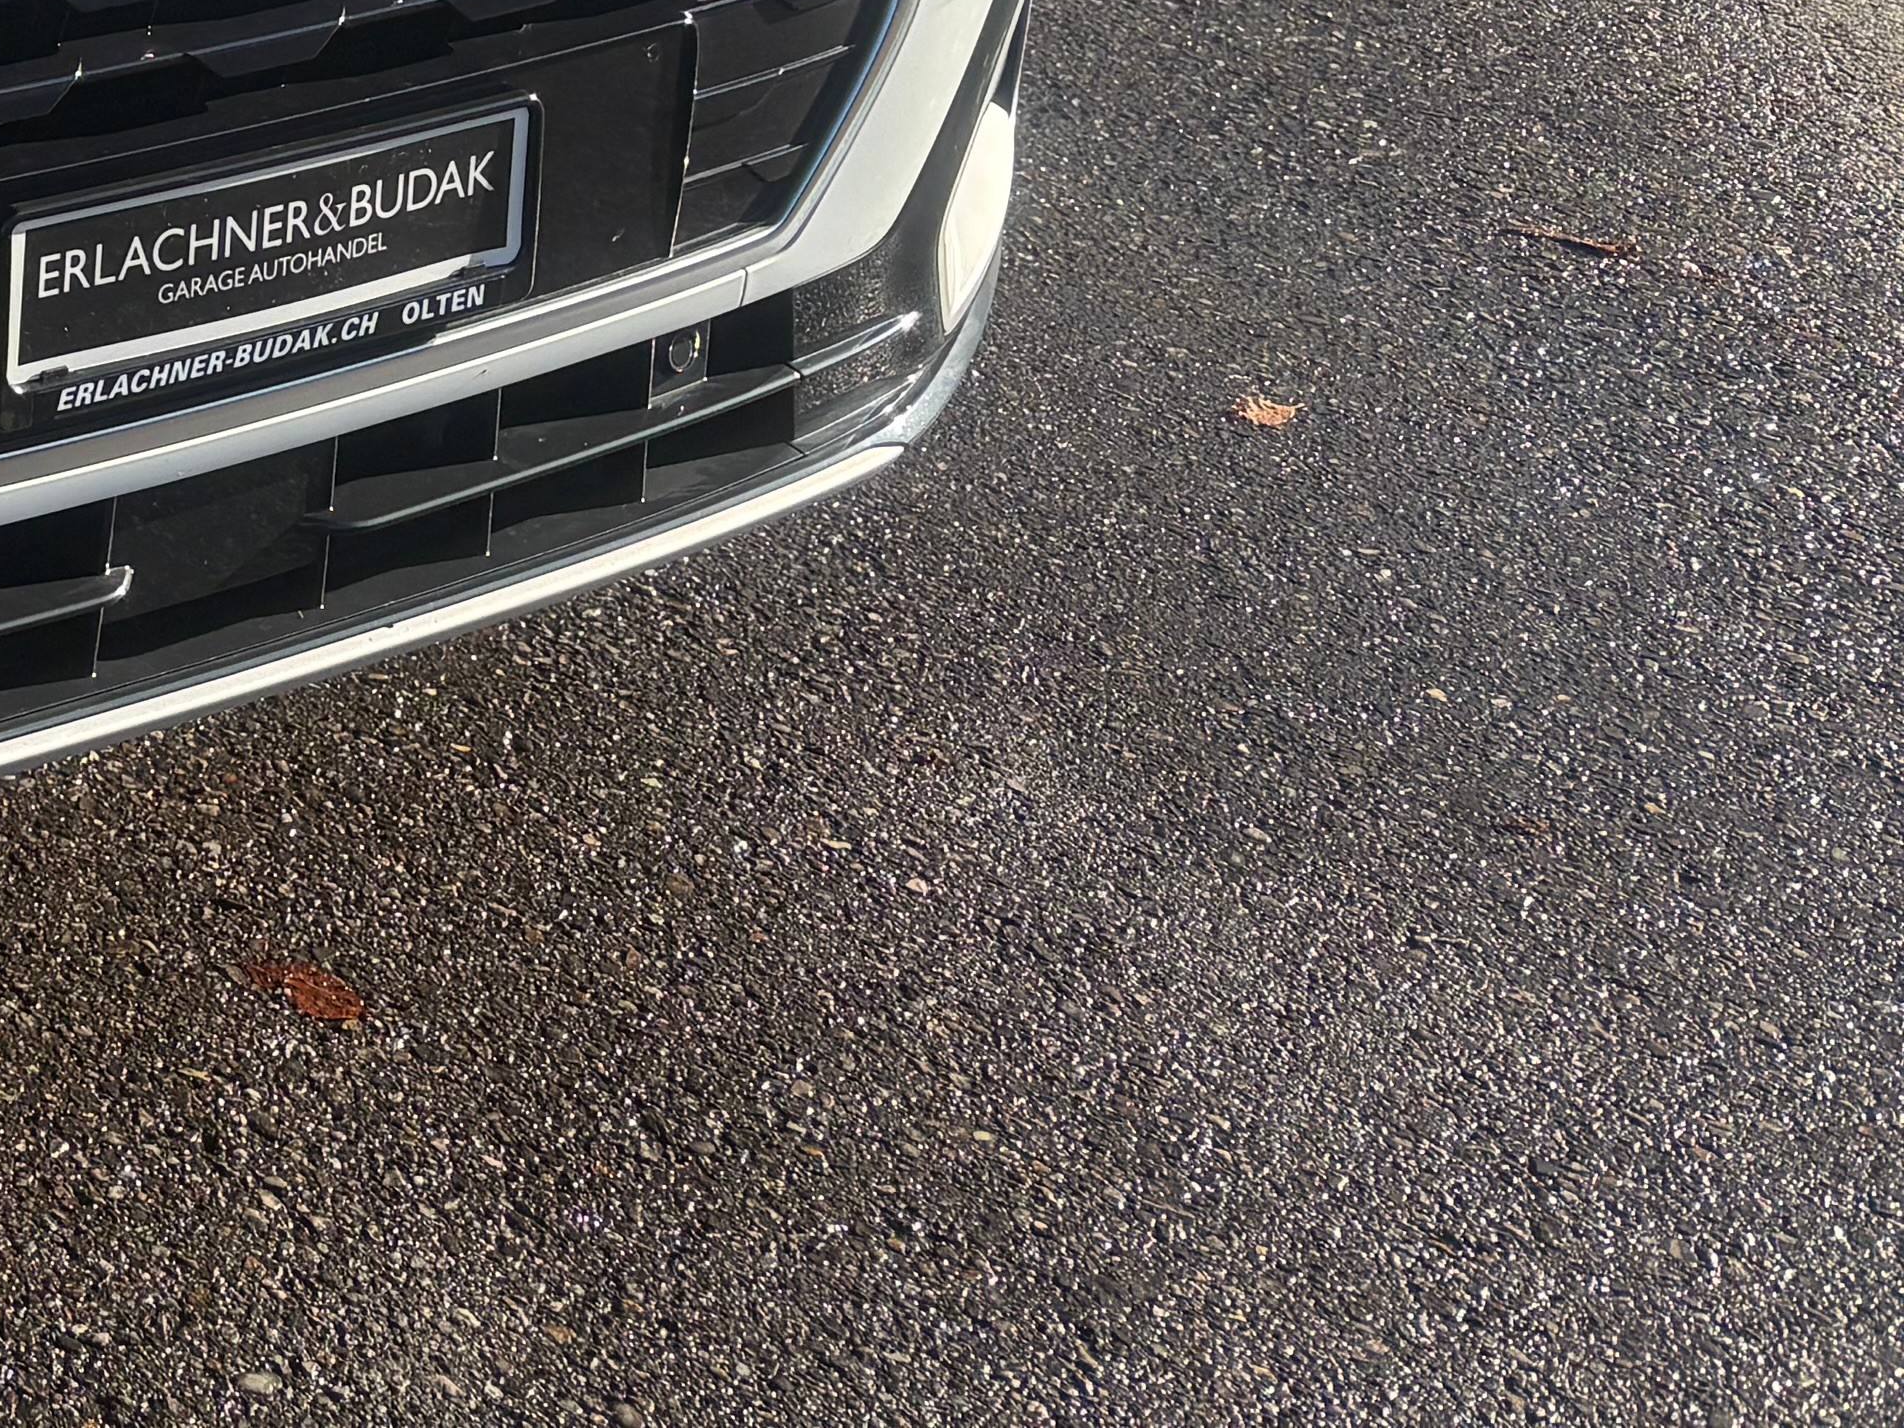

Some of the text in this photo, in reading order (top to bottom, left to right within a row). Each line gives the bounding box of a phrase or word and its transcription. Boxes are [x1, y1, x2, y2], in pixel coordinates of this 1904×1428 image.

[35, 150, 495, 300] ERLACHNER&BUDAK
[157, 231, 388, 306] GARAGE AUTOHANDEL
[56, 284, 486, 413] ERLACHNER-BUDAK.CH OLTEN
